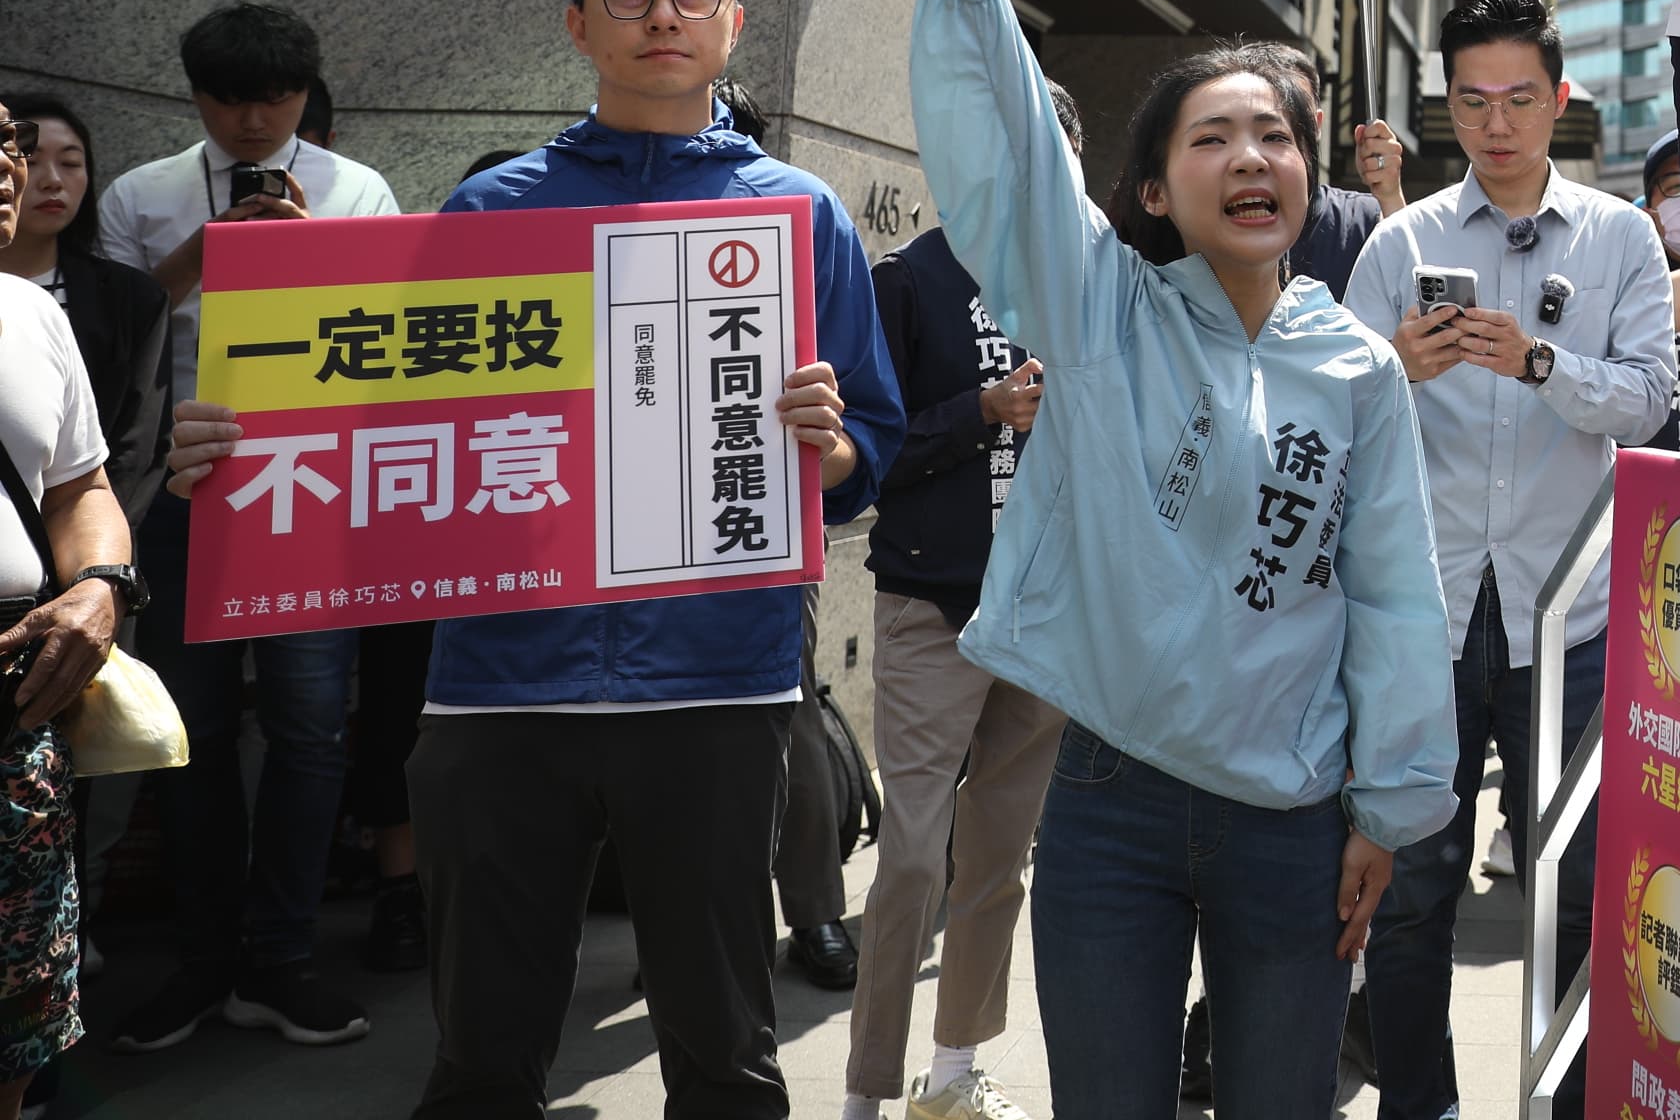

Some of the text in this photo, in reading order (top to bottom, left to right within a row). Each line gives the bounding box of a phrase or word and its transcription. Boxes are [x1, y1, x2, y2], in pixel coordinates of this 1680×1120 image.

[864, 180, 900, 236] 465
[227, 299, 563, 383] 一定要投
[634, 324, 656, 407] 同意罷免
[708, 307, 769, 555] 不同意罷免
[225, 412, 570, 535] 不同意
[1235, 421, 1330, 612] 徐巧芯
[223, 583, 401, 618] 立法委員徐巧芯
